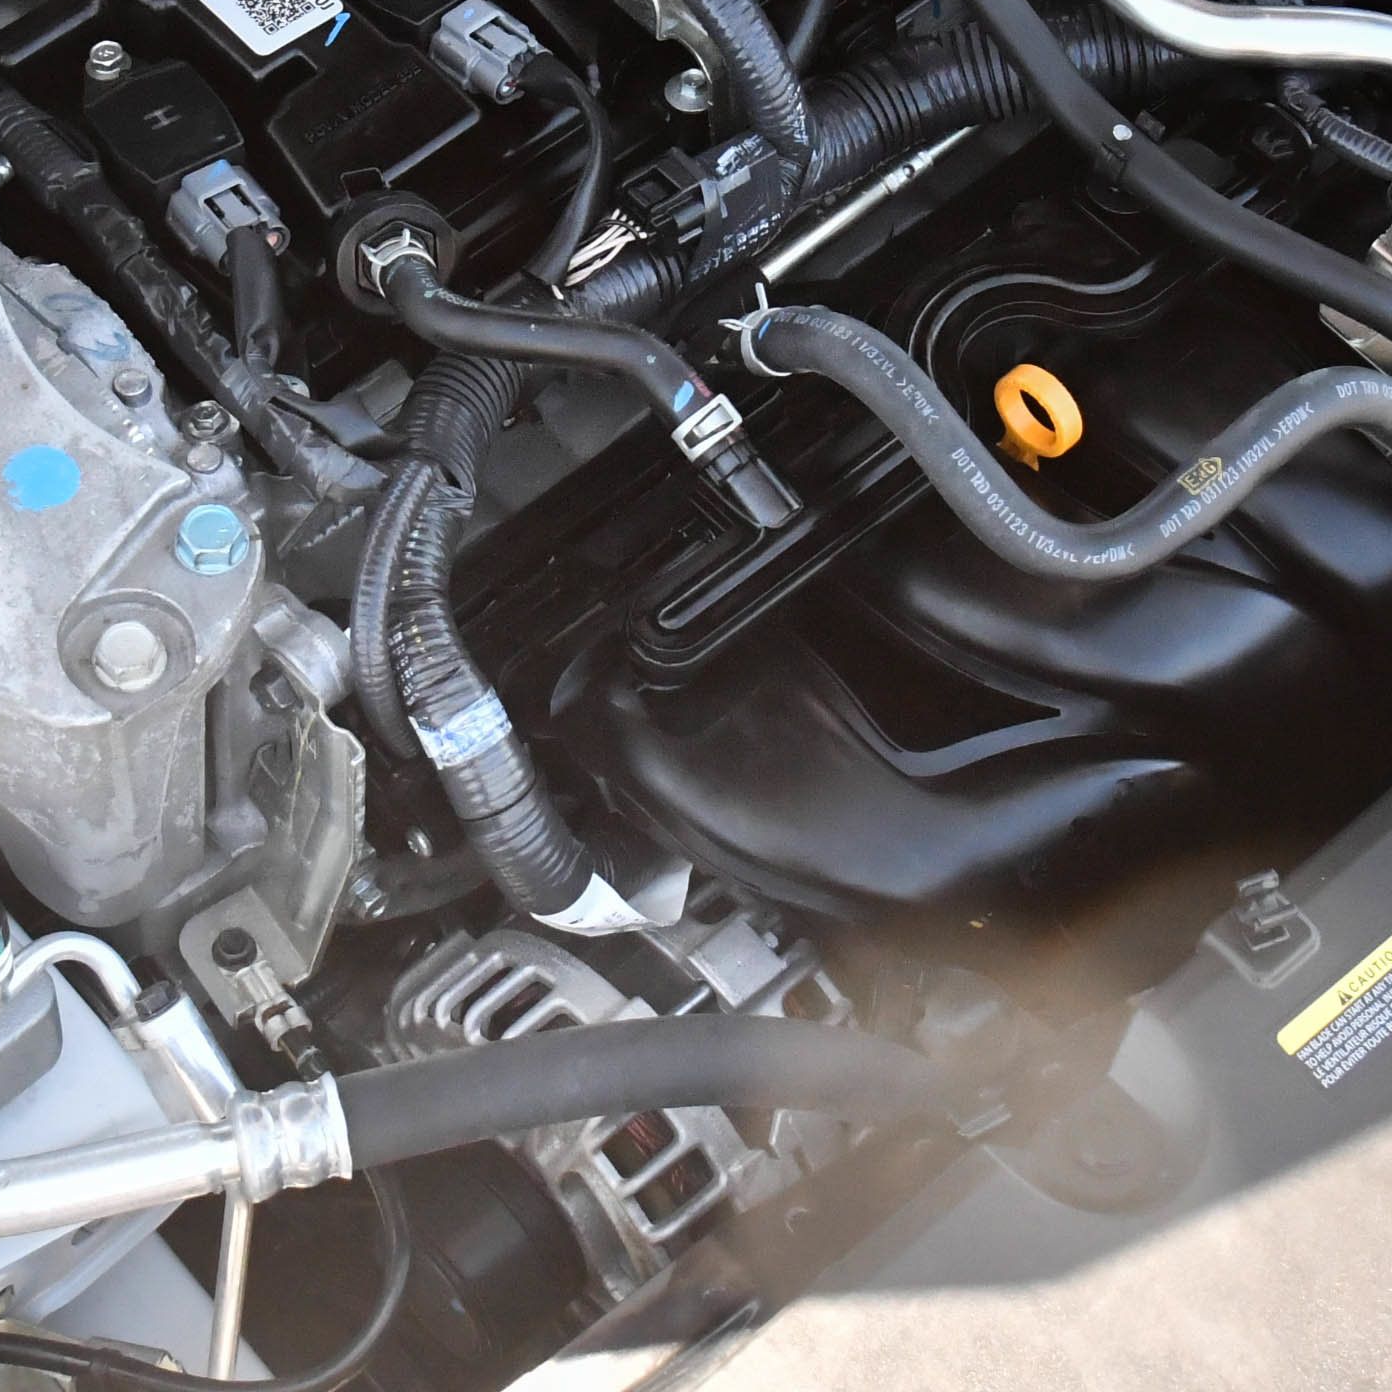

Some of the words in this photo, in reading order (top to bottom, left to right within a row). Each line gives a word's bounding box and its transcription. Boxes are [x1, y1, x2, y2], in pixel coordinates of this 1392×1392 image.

[1335, 381, 1357, 398] DOT
[950, 446, 977, 474] DOT
[984, 491, 1030, 537] 031123
[1158, 512, 1183, 539] DOT
[1197, 464, 1241, 506] 031123
[1295, 1045, 1314, 1060] FAN
[1308, 1027, 1334, 1049] BLADE
[1328, 1015, 1348, 1031] CAN
[1342, 999, 1366, 1019] START
[1360, 991, 1375, 1003] AT
[1369, 980, 1388, 996] ANY
[1304, 1057, 1319, 1069] TO
[1314, 1043, 1335, 1060] HELP
[1329, 1026, 1354, 1047] AVOID
[1349, 999, 1386, 1029] PERSONAL
[1311, 1067, 1326, 1078] LE
[1320, 1029, 1369, 1070] VENTILATEUR
[1320, 1067, 1344, 1087] POUR
[1363, 1027, 1390, 1049] TOUTE
